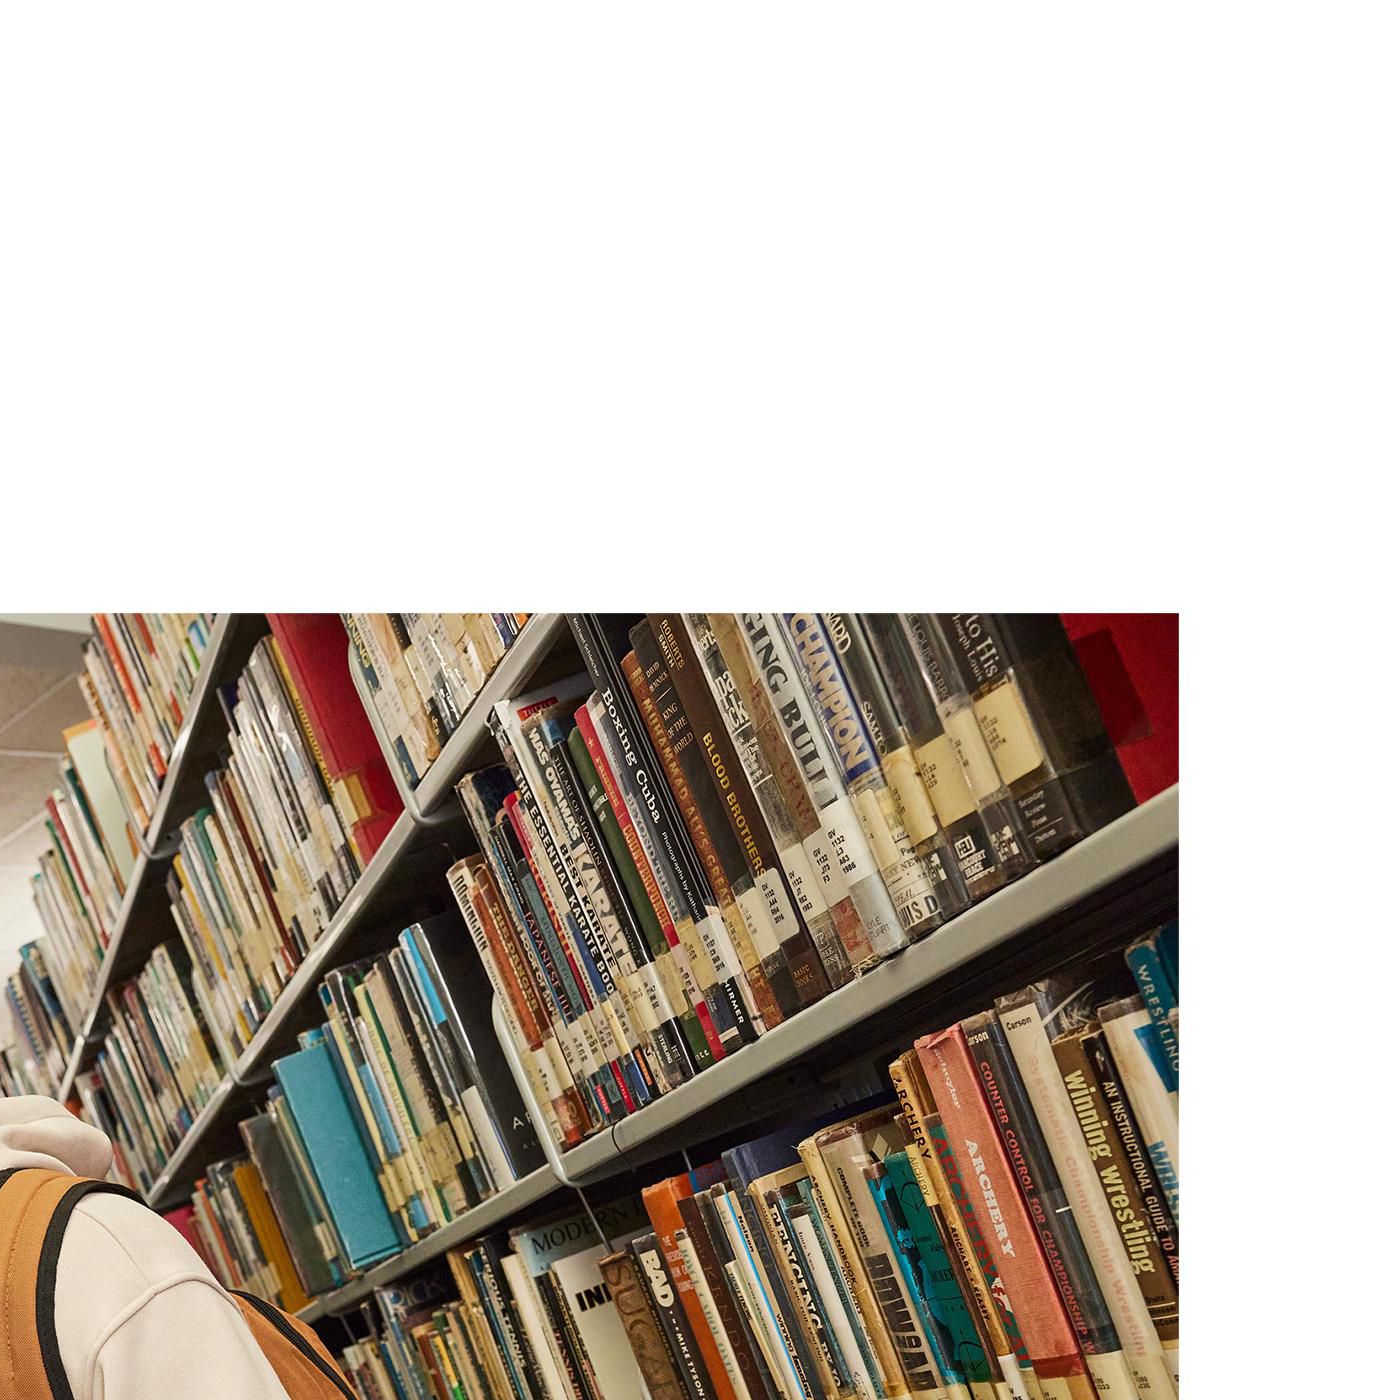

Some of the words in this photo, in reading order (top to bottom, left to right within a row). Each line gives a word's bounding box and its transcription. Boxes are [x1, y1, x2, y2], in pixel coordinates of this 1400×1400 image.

[658, 634, 675, 668] SMITH
[661, 619, 684, 669] ROBERTS
[949, 613, 972, 649] Joseph
[965, 650, 986, 681] Louis
[974, 640, 1001, 677] His
[662, 703, 678, 720] KING
[674, 716, 687, 734] THE
[783, 613, 873, 770] CHAMPION
[525, 728, 551, 766] MAS
[541, 765, 584, 841] OYAMA'S
[571, 617, 586, 644] Michael
[596, 686, 640, 767] Boxing
[632, 768, 665, 824] Cuba
[659, 830, 685, 880] Photographs
[680, 880, 689, 891] by
[638, 697, 692, 801] MUHAMMAD
[683, 804, 710, 849] ALI'S
[672, 732, 694, 754] WORLD
[576, 815, 603, 866] SHAOLIN
[699, 731, 732, 790] BLOOD
[723, 792, 768, 877] BROTHERS
[828, 829, 836, 838] GV
[832, 836, 845, 847] 1132
[512, 771, 533, 804] THE
[527, 806, 574, 896] ESSENTIAL
[565, 895, 599, 957] KARATE
[619, 823, 674, 930] COUNTERPUNCH
[812, 848, 820, 858] GV
[816, 854, 828, 866] 1132
[521, 912, 564, 992] JAPANESE
[557, 843, 584, 891] BEST
[578, 895, 618, 969] KARATE
[722, 981, 744, 1026] HIRMER
[1006, 1016, 1032, 1031] Carson
[835, 1166, 859, 1219] COMPLETE
[893, 1078, 932, 1160] ARCHERY
[949, 1225, 972, 1273] REICHART
[971, 1284, 990, 1321] KEASEY
[909, 1155, 930, 1197] ARCHERY
[931, 1131, 999, 1282] ARCHERY
[961, 1136, 1017, 1260] ARCHERY
[978, 1060, 1010, 1125] COUNTER
[1003, 1128, 1034, 1193] CONTROL
[1028, 1196, 1046, 1224] FOR
[1042, 1230, 1088, 1336] CHAMPIONSHIP
[1064, 1069, 1113, 1161] winning
[1100, 1165, 1156, 1276] wrestling
[1102, 1081, 1118, 1098] AN
[1110, 1101, 1152, 1193] INSTRUCTIONAL
[1146, 1196, 1168, 1233] GUIDE
[1160, 1236, 1175, 1252] TO
[760, 1203, 829, 1331] FENCING
[807, 1174, 834, 1221] ARCHERY
[825, 1223, 859, 1285] HANDBOOK
[474, 1245, 509, 1311] SERIOUS
[499, 1312, 529, 1369] TENNIS
[637, 1247, 678, 1310] BAD
[674, 1332, 691, 1359] MIKE
[685, 1360, 707, 1397] TYSON
[697, 1262, 756, 1371] KENDO
[772, 1312, 796, 1353] winning
[550, 1330, 578, 1379] TENNIS
